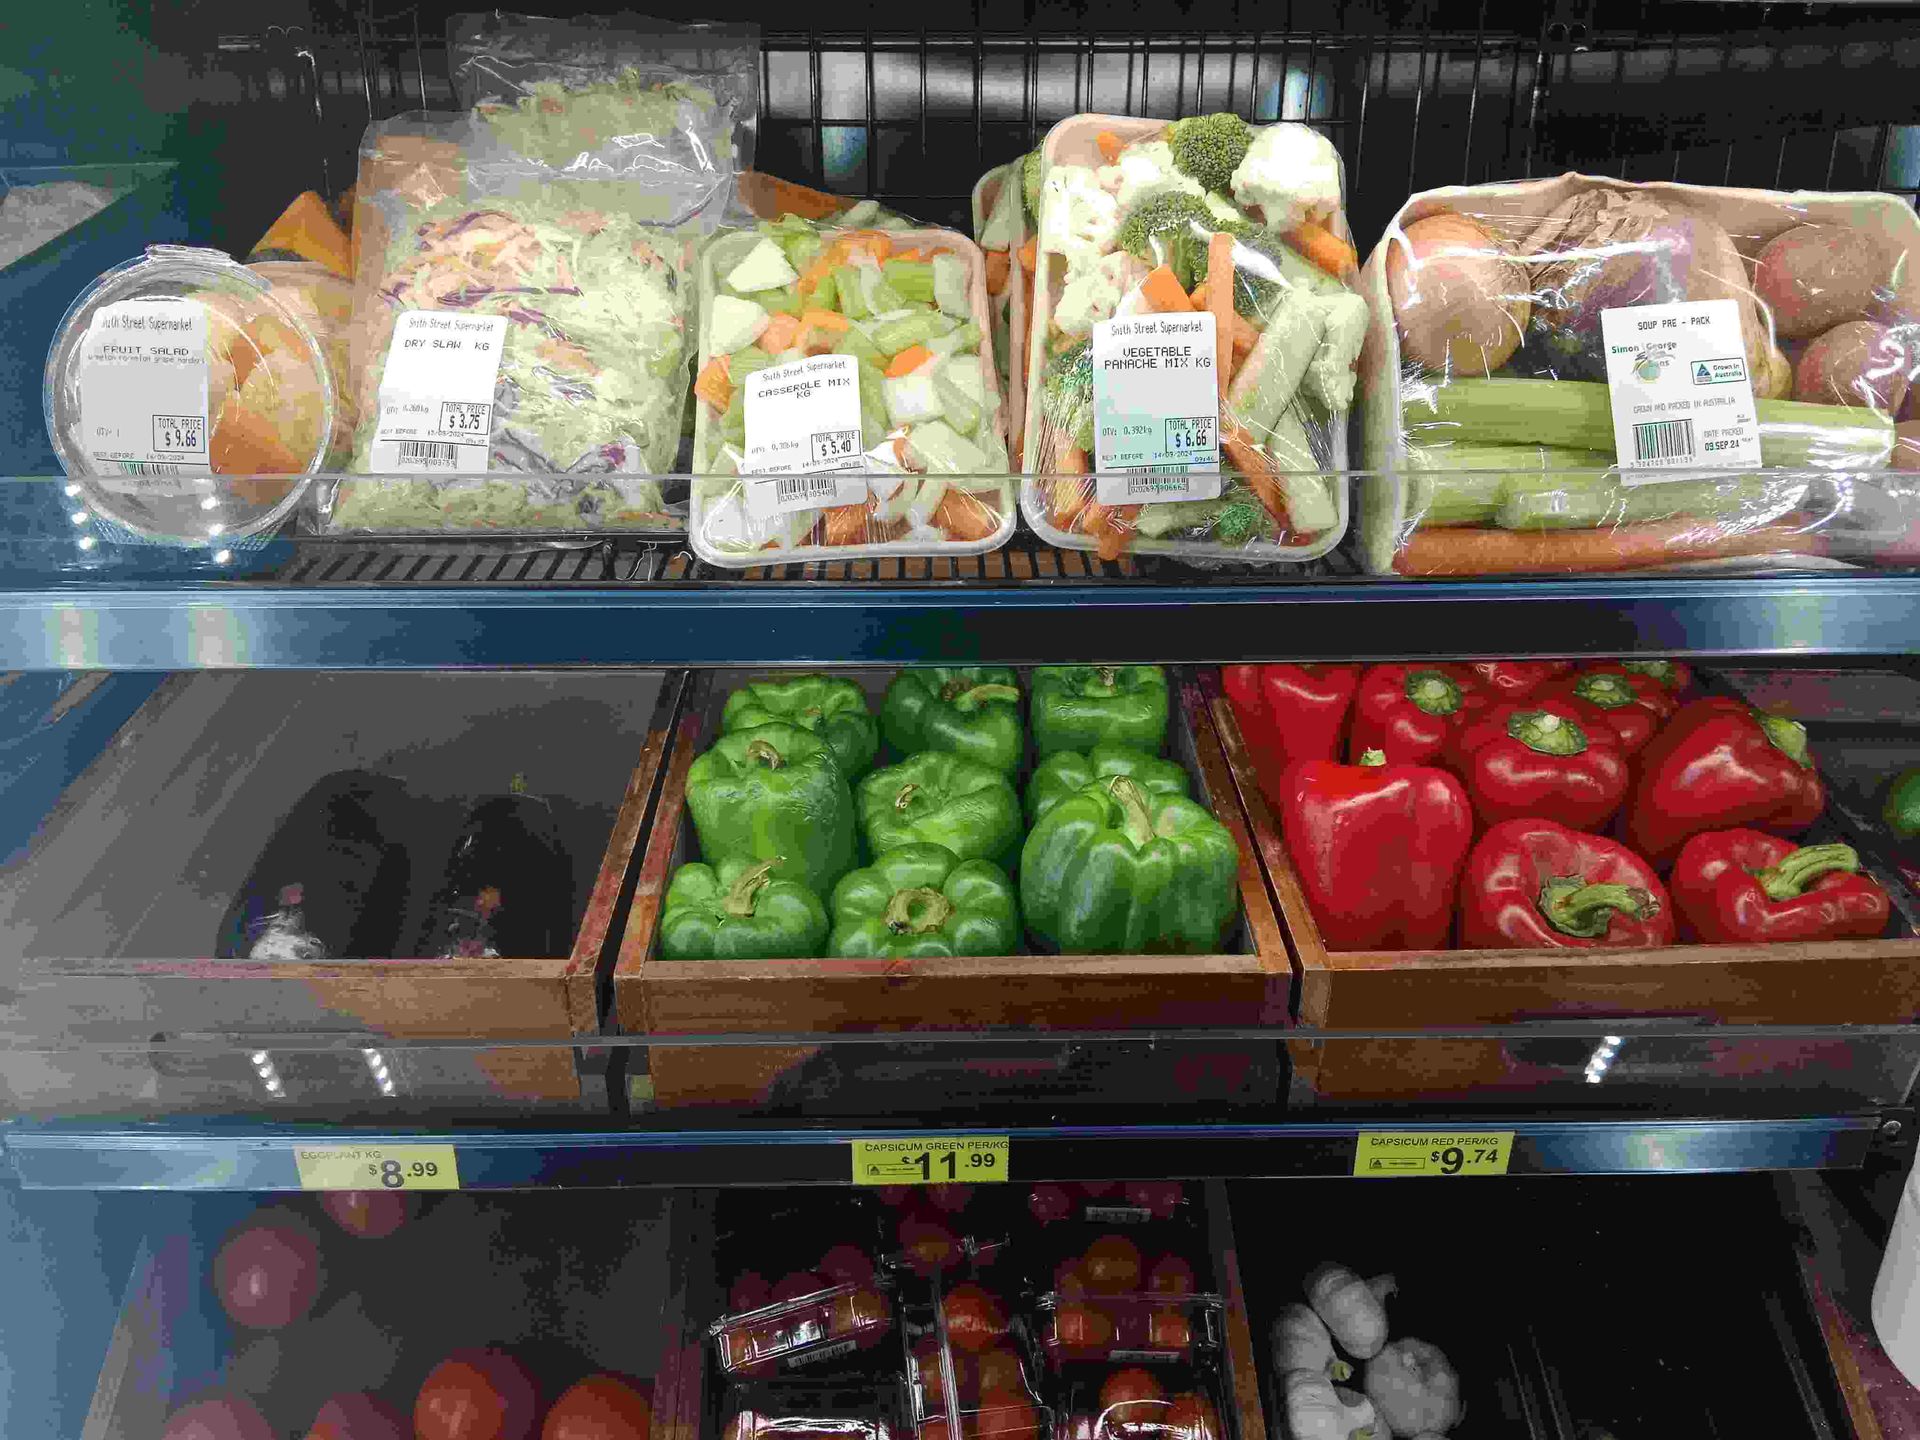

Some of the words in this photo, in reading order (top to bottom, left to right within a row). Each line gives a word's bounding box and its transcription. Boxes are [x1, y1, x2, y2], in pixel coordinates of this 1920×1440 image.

[122, 315, 145, 329] Street
[149, 316, 193, 334] Supermarket
[430, 318, 451, 330] Street
[454, 320, 494, 332] Supermarket
[1134, 322, 1158, 334] Street
[1160, 320, 1203, 335] Supermarket
[1638, 320, 1658, 331] SOUP
[1662, 318, 1677, 328] PRE
[1690, 316, 1710, 326] PACK
[103, 345, 142, 354] FRUIT
[150, 346, 189, 356] SALAD
[404, 339, 426, 348] DRY
[432, 340, 462, 350] SLAW
[474, 342, 490, 351] KG
[1611, 344, 1640, 354] Simon
[1123, 346, 1192, 358] VEGETABLE
[783, 366, 804, 378] Street
[806, 361, 846, 372] Supermarket
[1104, 358, 1158, 370] PANACHE
[1165, 358, 1188, 368] MIX
[1196, 358, 1211, 368] KG
[1714, 370, 1742, 379] Australia
[758, 380, 822, 398] CASSEROLE
[828, 377, 850, 387] MIX
[796, 390, 811, 399] KG
[1702, 396, 1736, 408] AUSTRALIA
[446, 404, 464, 414] TOTAL
[466, 405, 486, 416] PRICE
[158, 418, 178, 430] TOTAL
[181, 418, 202, 430] PRICE
[459, 414, 480, 430] 3.75
[1168, 420, 1188, 430] TOTAL
[1192, 418, 1212, 430] PRICE
[175, 429, 197, 447] 9.66
[816, 434, 834, 443] TOTAL
[836, 432, 856, 440] PRICE
[1186, 430, 1207, 447] 6.66
[1704, 429, 1720, 438] DATE
[830, 440, 852, 455] 5.40
[865, 1142, 923, 1152] CAPSICUM
[926, 1141, 964, 1151] GREEN
[968, 1140, 1009, 1150] PER/KG
[1371, 1137, 1428, 1146] CAPSICUM
[1431, 1137, 1455, 1146] RED
[1458, 1136, 1498, 1146] PER/KG
[301, 1151, 361, 1160] EGGPLANT
[365, 1150, 382, 1159] KG
